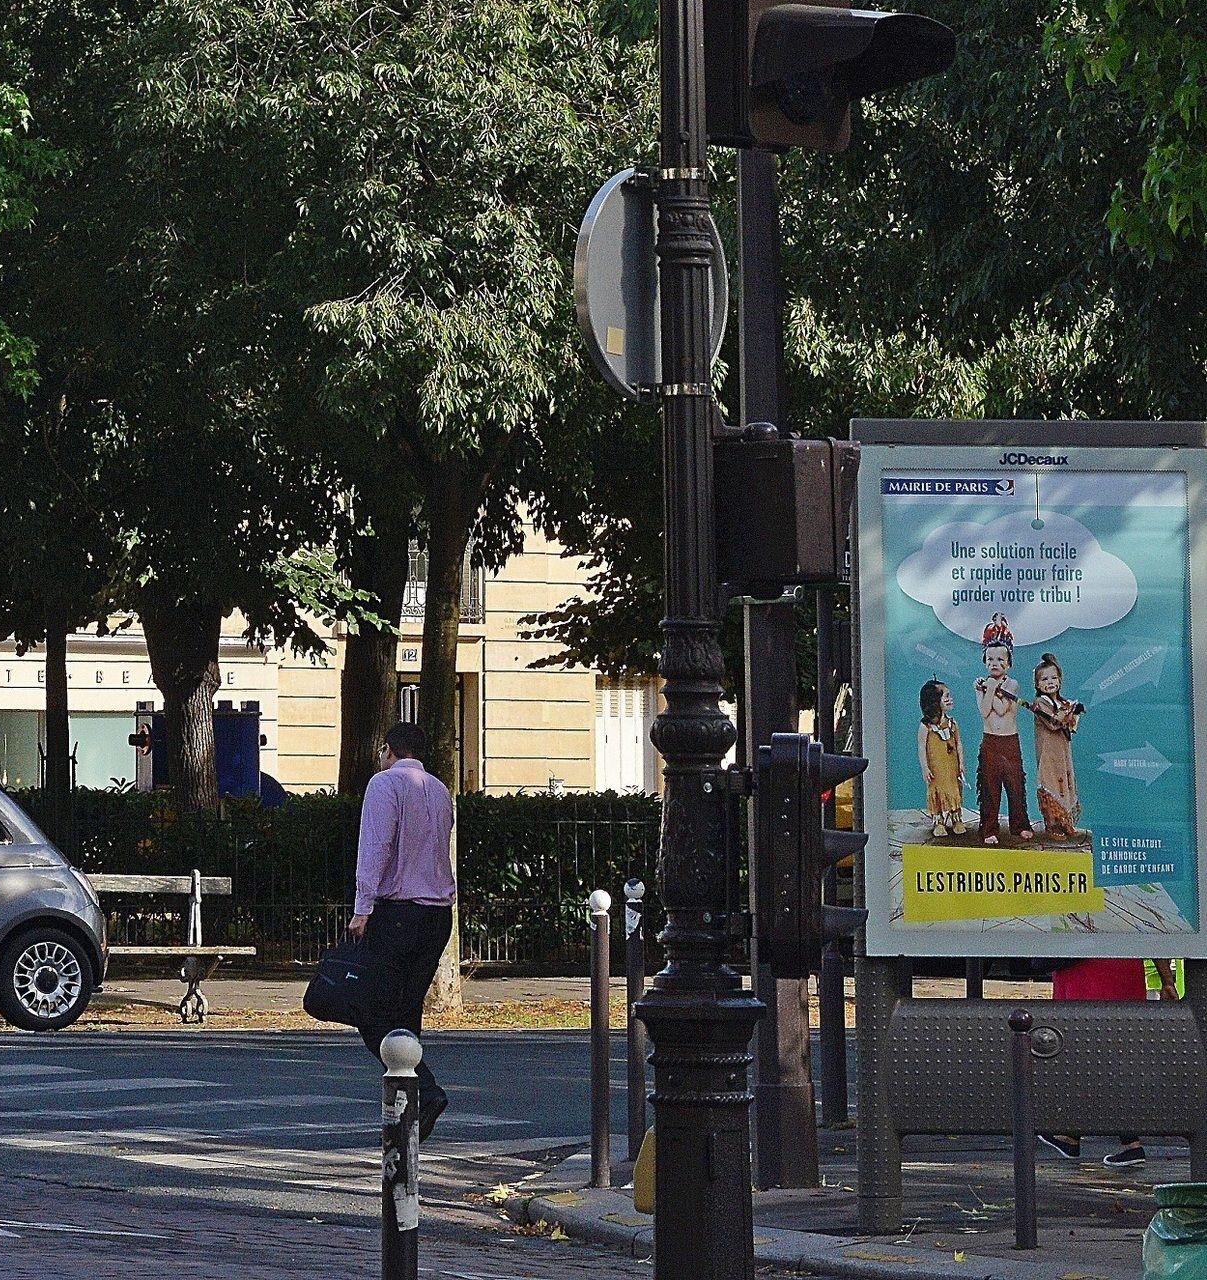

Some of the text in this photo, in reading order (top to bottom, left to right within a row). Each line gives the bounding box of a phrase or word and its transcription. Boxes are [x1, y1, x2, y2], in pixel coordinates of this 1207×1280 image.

[999, 452, 1069, 465] JCDecaux
[889, 482, 988, 492] MAIRIE DE PARIS
[951, 541, 1077, 559] Une solution facile
[952, 564, 1083, 585] et rapide pour faire
[952, 586, 995, 606] garder
[1000, 587, 1035, 602] votre
[1039, 586, 1072, 602] tribu
[402, 649, 418, 662] 12
[1101, 837, 1162, 849] LE SITE GRATUIT
[1101, 851, 1147, 861] D'ANNONCES
[1101, 863, 1175, 875] DE GARDE D'ENFANT
[916, 871, 1088, 894] LESTRIBUS.PARIS.FR
